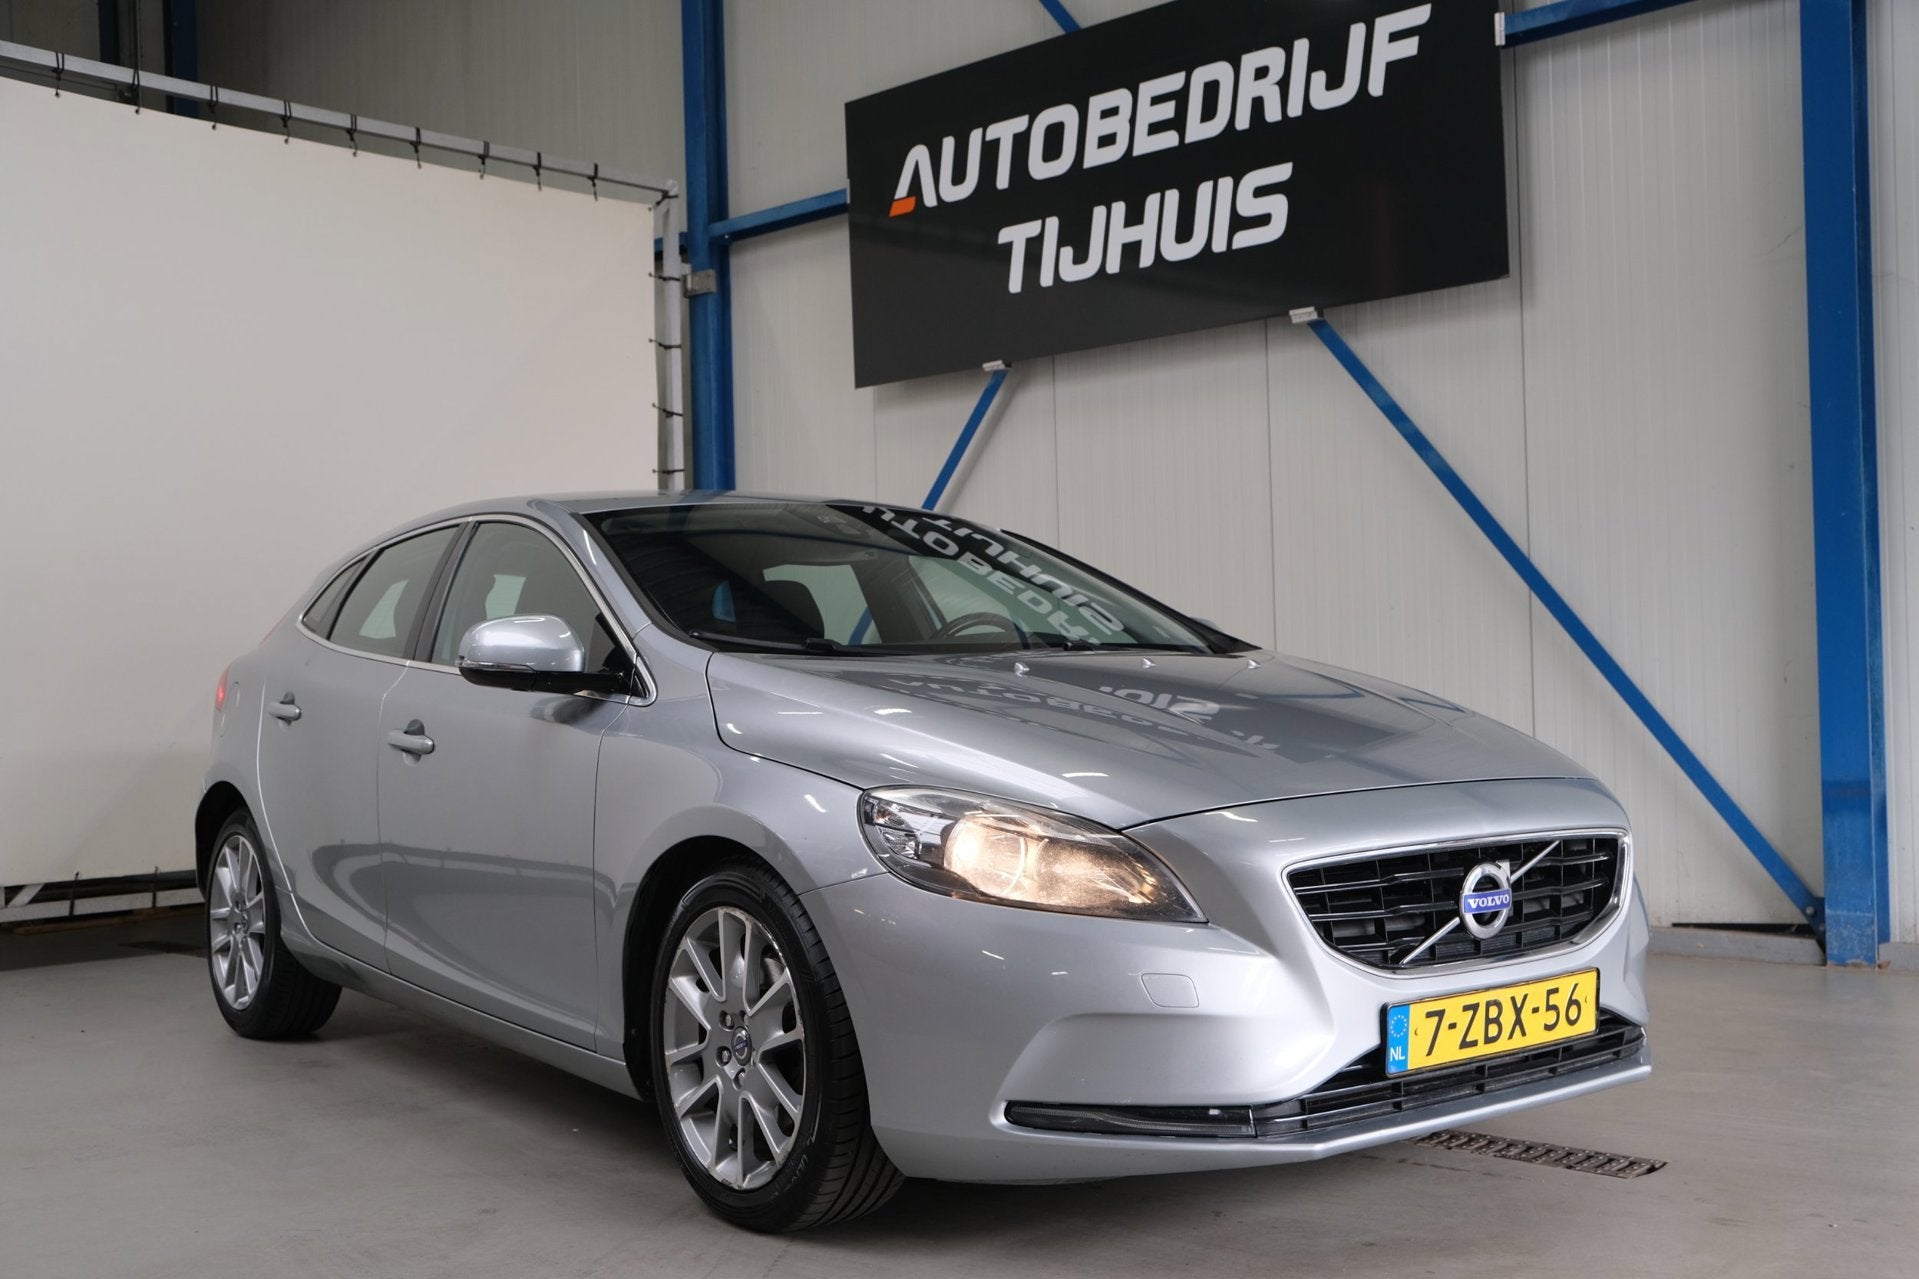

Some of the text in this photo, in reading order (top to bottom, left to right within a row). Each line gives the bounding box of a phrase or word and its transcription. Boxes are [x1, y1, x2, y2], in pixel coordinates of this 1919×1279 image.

[889, 3, 1431, 217] AUTOBEDRIJF
[998, 162, 1293, 294] TIJHUIS
[1467, 894, 1510, 909] VOLVO
[1390, 1045, 1405, 1062] NL
[1425, 983, 1582, 1057] 7-ZBX-56
